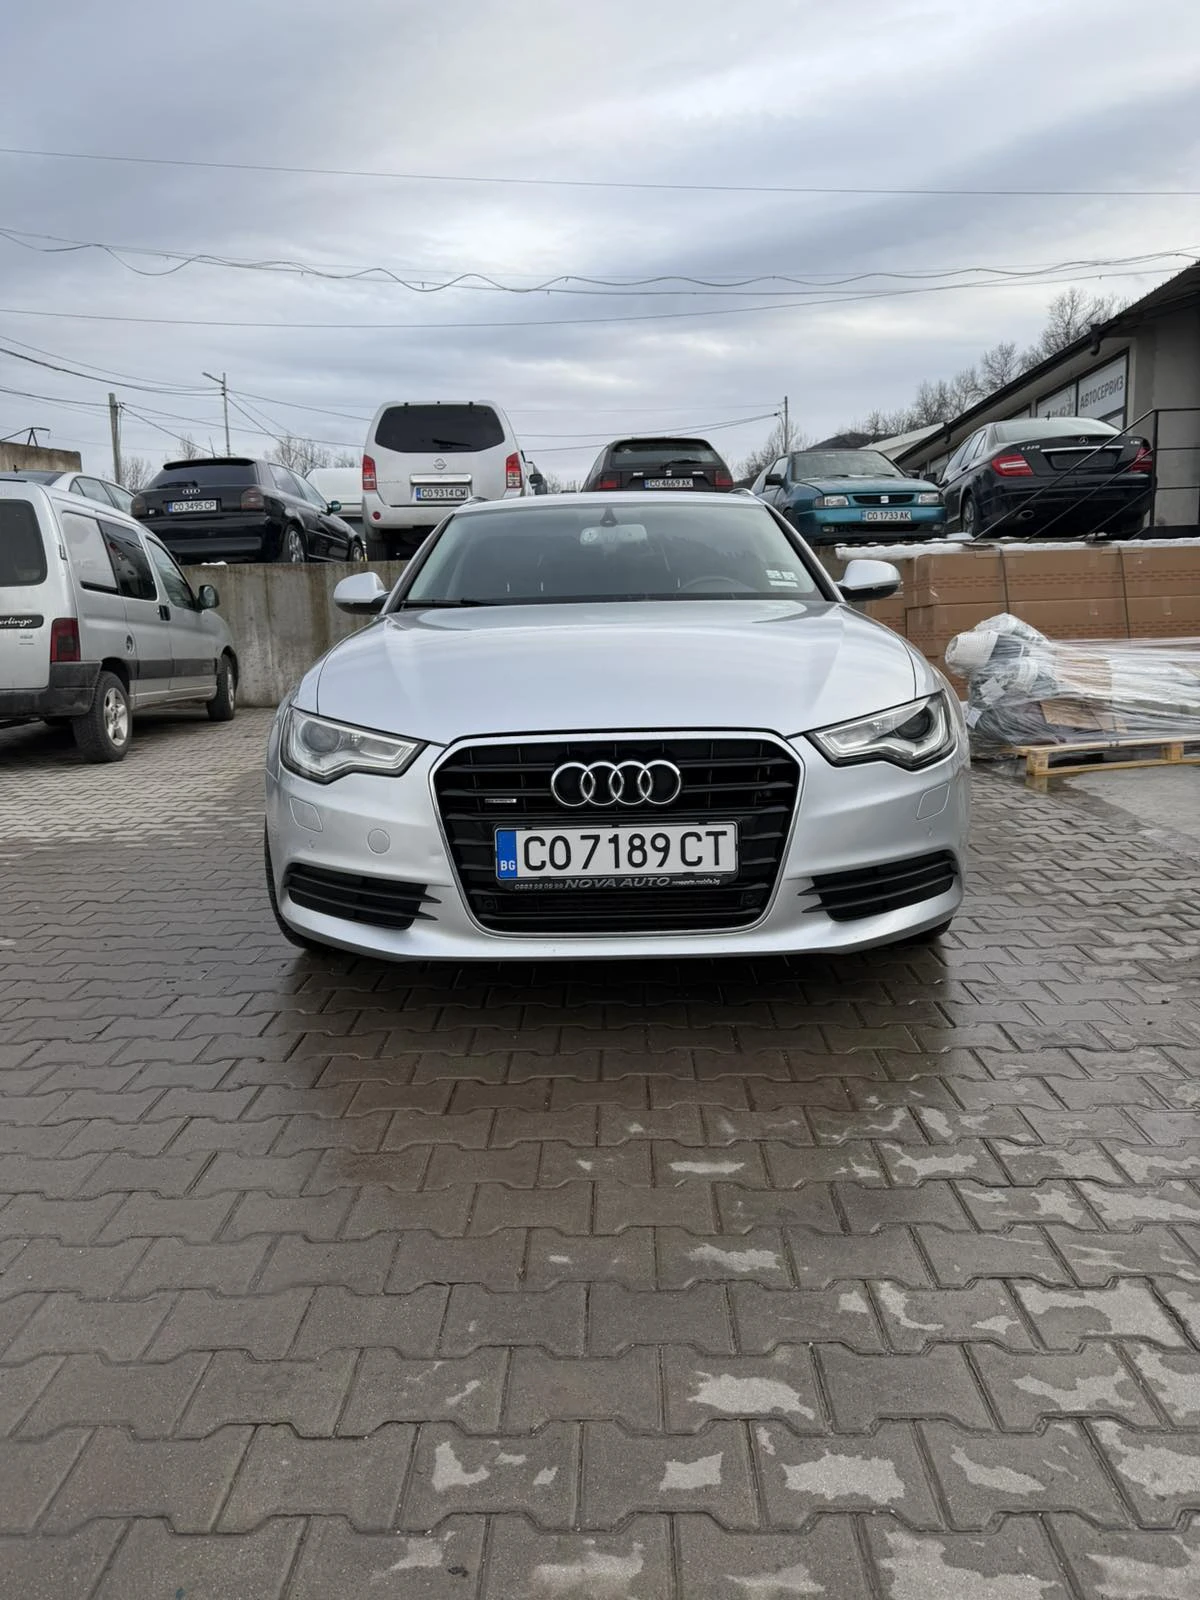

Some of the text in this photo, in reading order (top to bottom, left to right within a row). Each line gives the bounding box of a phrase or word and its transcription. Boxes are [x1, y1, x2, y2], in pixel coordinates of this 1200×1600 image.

[1080, 375, 1124, 408] АВТОСЕРВИЗ
[0, 617, 33, 627] erlingo
[500, 860, 516, 871] BG
[565, 876, 671, 889] NOVA AUTO
